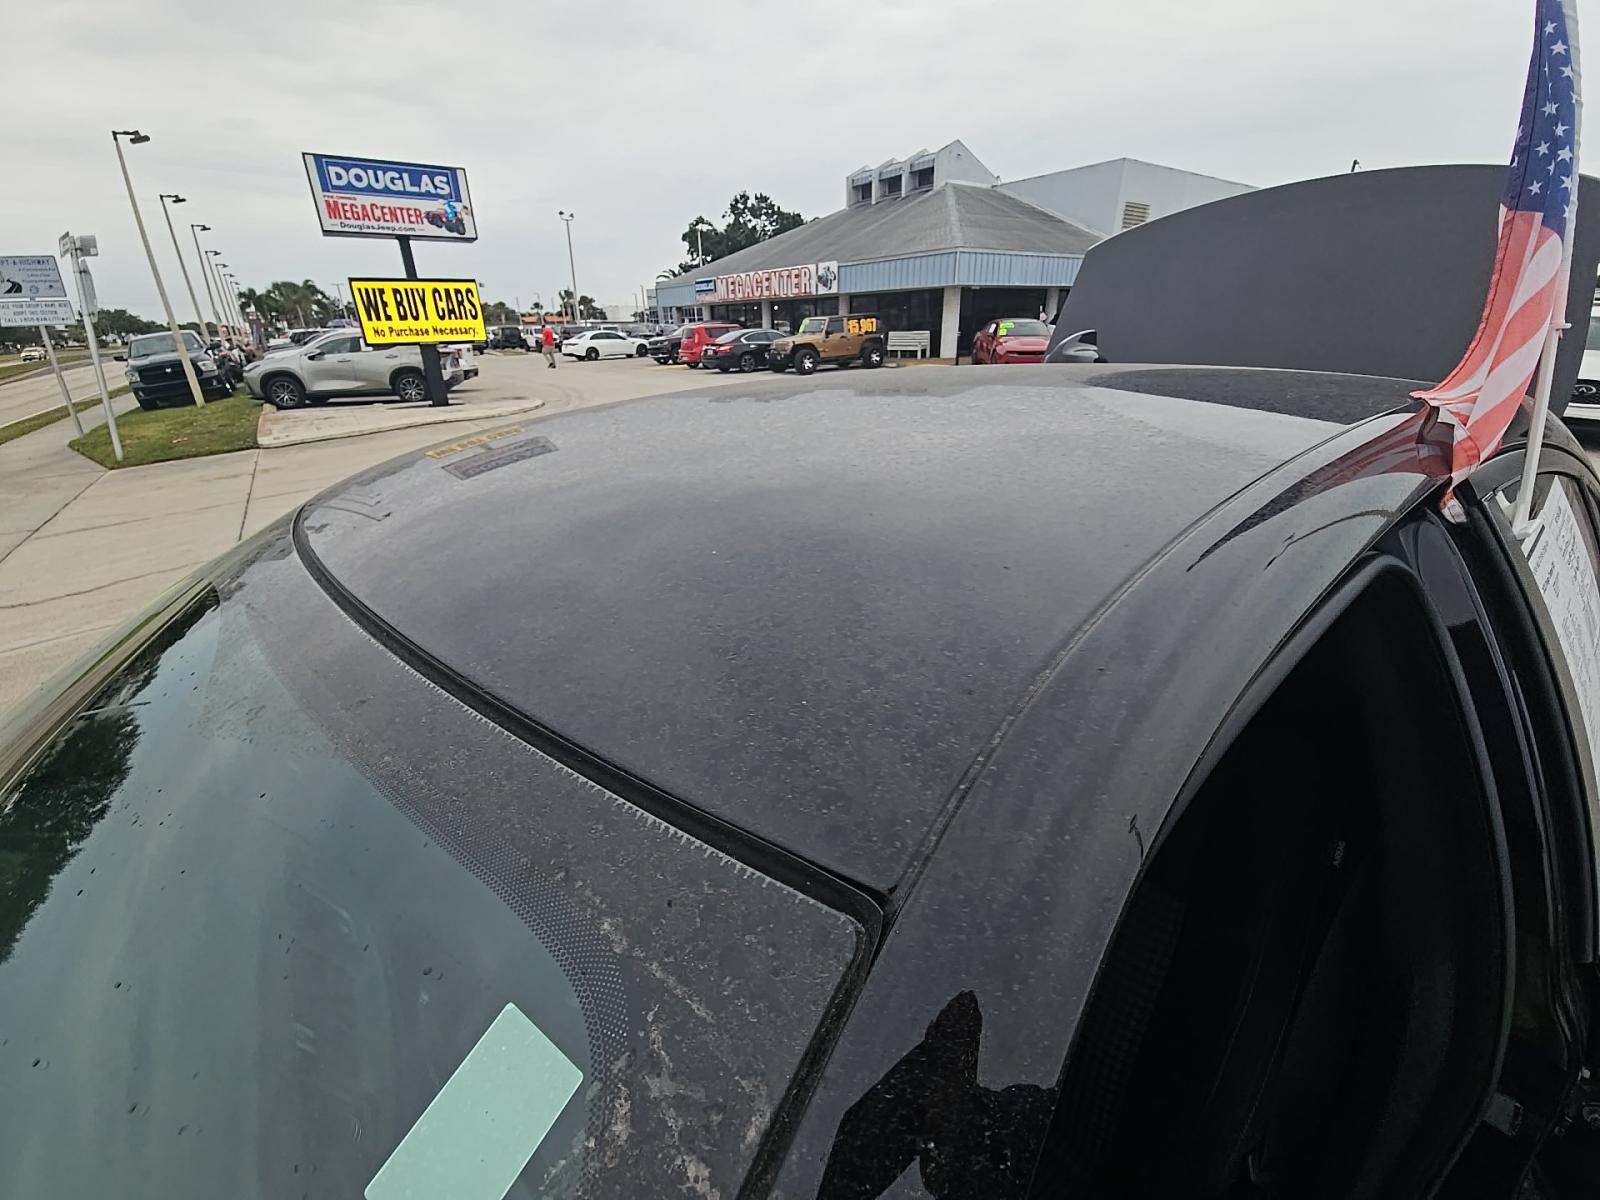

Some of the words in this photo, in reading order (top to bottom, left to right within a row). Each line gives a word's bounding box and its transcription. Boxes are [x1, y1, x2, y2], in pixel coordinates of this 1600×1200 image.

[327, 166, 451, 196] DOUGLAS
[717, 266, 812, 301] MEGACENTER
[357, 287, 393, 321] WE
[392, 287, 429, 321] BUY
[431, 287, 479, 321] CARS
[372, 326, 386, 337] No
[389, 326, 430, 337] Purchase
